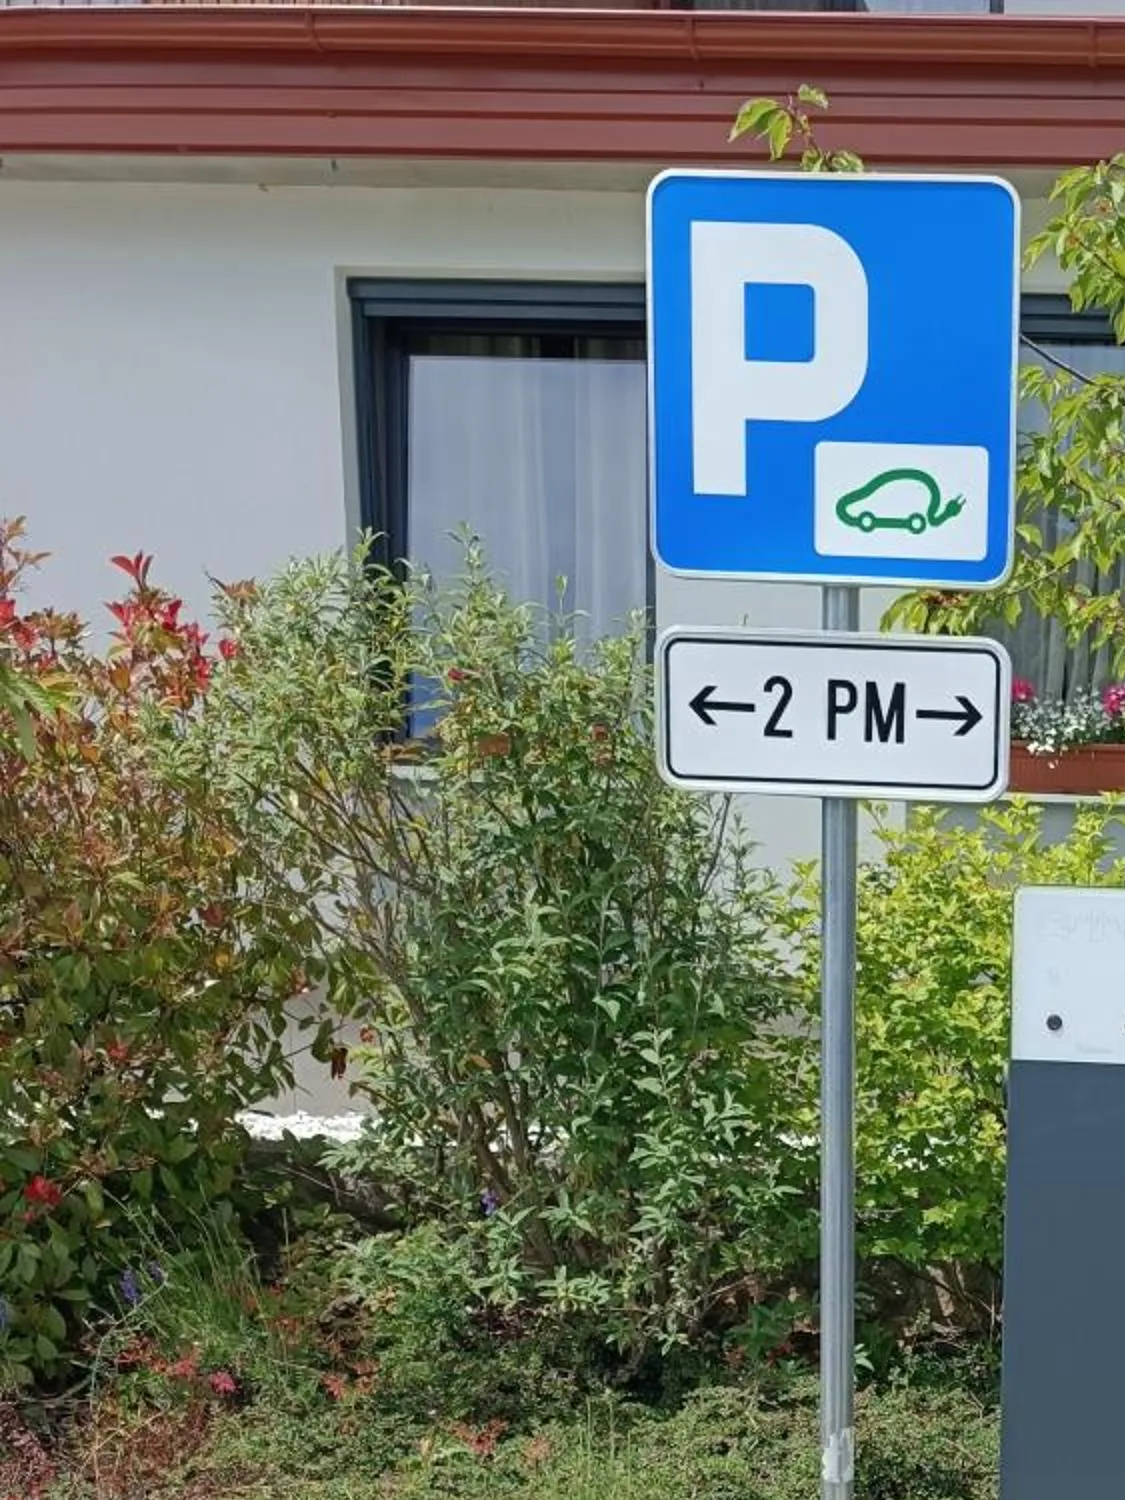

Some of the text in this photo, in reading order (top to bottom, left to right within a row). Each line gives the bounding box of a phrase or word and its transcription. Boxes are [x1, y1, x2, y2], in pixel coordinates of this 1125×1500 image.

[691, 221, 869, 496] P
[763, 676, 906, 744] 2 PM
